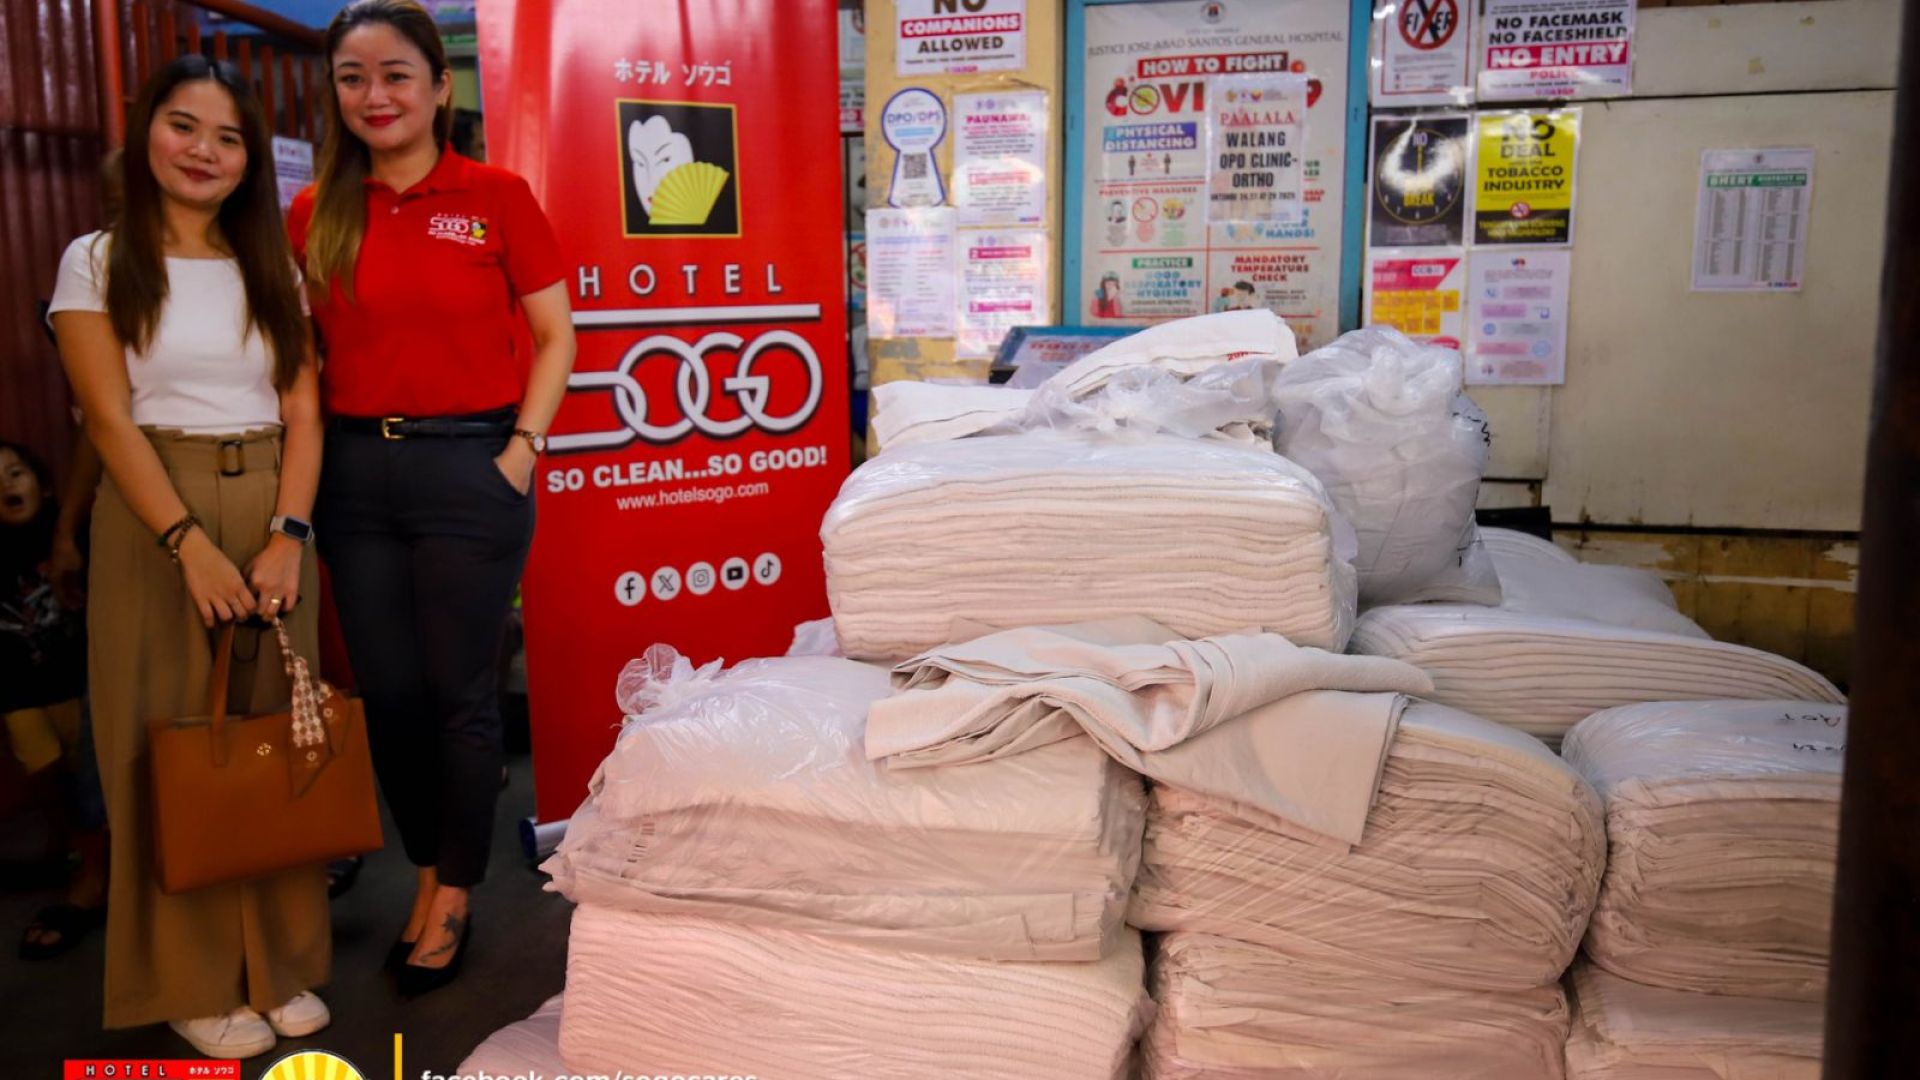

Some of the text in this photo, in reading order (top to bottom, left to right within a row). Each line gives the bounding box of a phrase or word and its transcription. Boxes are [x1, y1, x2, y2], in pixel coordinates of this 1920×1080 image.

[933, 0, 987, 14] NO
[903, 15, 1019, 35] COMPANIONS
[1495, 11, 1623, 29] NO FACEMASK
[1185, 34, 1232, 47] SANTOS
[1234, 33, 1285, 46] GENERAL
[1288, 31, 1343, 43] HOSPITAL
[1489, 26, 1628, 45] NO FACESHIELD
[918, 37, 1004, 53] ALLOWED
[1490, 43, 1626, 68] NO ENTRY
[615, 58, 732, 87] ホテル ソウゴ
[1143, 55, 1283, 75] HOW TO FIGHT
[1220, 111, 1296, 126] PAALALA
[1116, 124, 1185, 138] PHYSICAL
[1105, 137, 1194, 150] DISTANCING
[1226, 131, 1286, 148] WALANG
[1412, 132, 1428, 147] NO
[1500, 143, 1556, 159] DEAL
[1220, 153, 1246, 169] OPD
[1251, 151, 1298, 168] CLINIC-
[1232, 172, 1274, 188] ORTHO
[1487, 166, 1564, 178] TOBACCO
[1483, 179, 1565, 192] INDUSTRY
[1234, 256, 1306, 264] MANDATORY
[1231, 264, 1309, 273] TEMPERATURE
[578, 263, 782, 298] HOTEL
[1252, 273, 1287, 282] CHECK
[546, 304, 823, 452] SOGO
[547, 469, 585, 493] SO
[749, 446, 827, 472] GOOD!
[616, 480, 769, 510] www.hotelsogo.com
